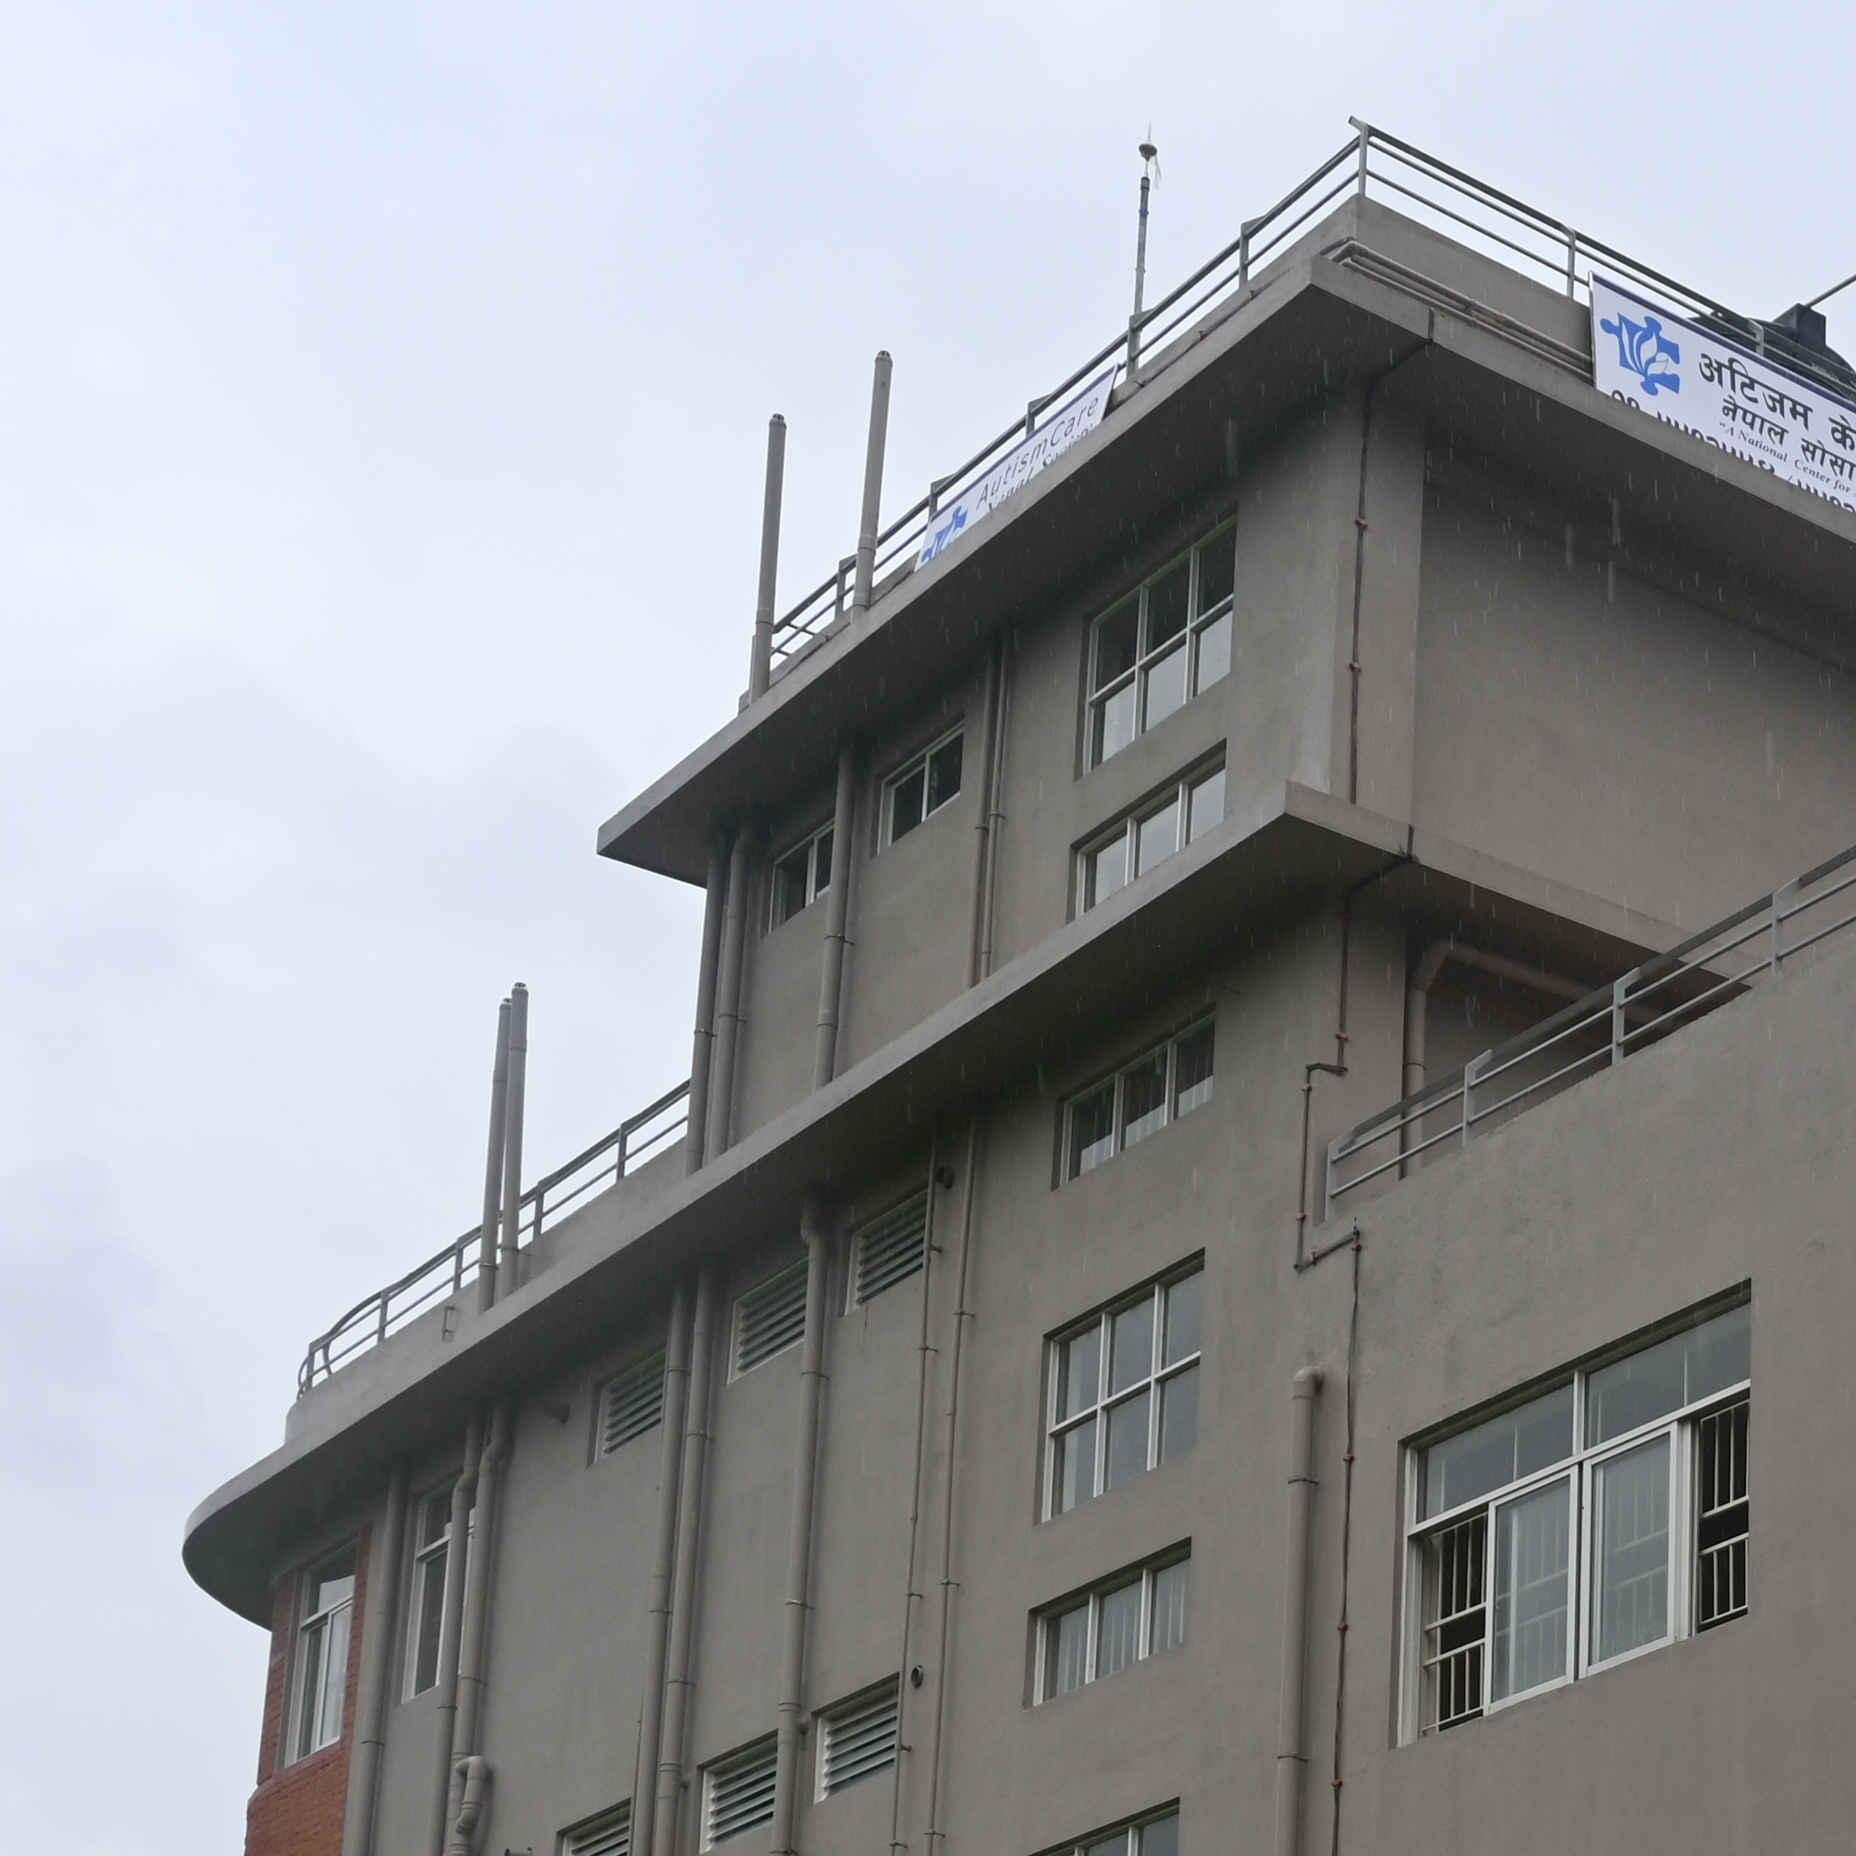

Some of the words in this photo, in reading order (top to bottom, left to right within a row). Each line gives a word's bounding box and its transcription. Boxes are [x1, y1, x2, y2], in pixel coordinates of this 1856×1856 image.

[1699, 352, 1813, 430] अटिजम
[1722, 395, 1789, 446] नेपाल
[976, 397, 1099, 511] AutismCare
[1738, 430, 1788, 462] National
[1794, 459, 1831, 484] Center
[1833, 479, 1850, 493] for
